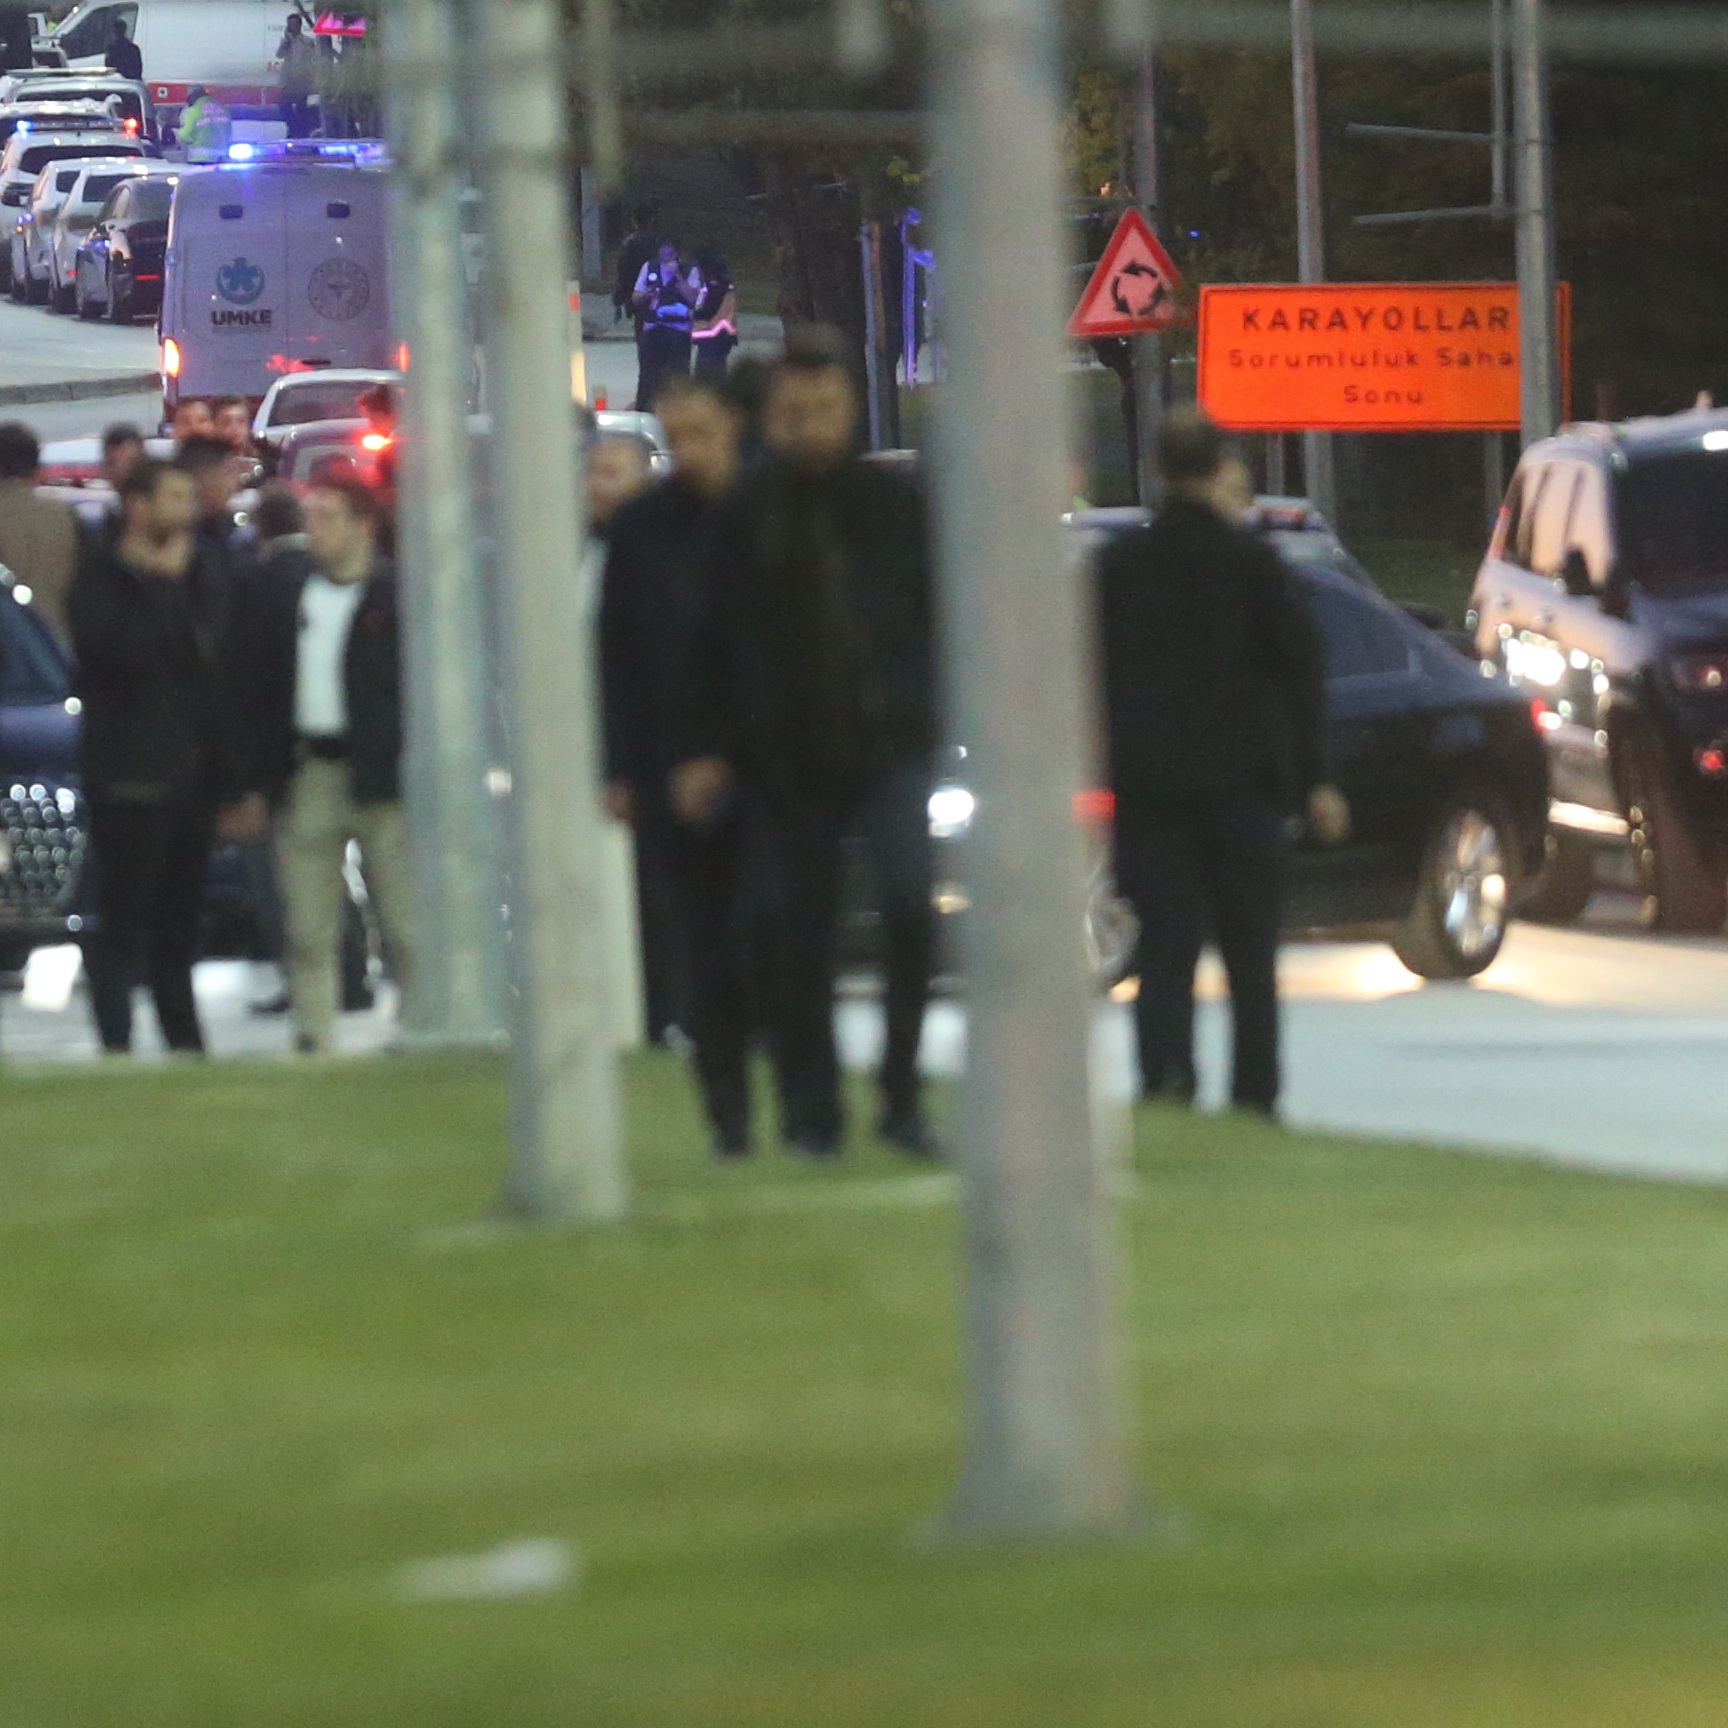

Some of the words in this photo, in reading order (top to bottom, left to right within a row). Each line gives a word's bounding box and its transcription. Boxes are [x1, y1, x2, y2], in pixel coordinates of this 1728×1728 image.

[212, 310, 271, 325] UMKE
[1242, 305, 1512, 332] KARAYOLLAR
[1228, 347, 1420, 369] Sorumluluk
[1436, 346, 1516, 368] Saha
[1343, 384, 1424, 404] Sonu
